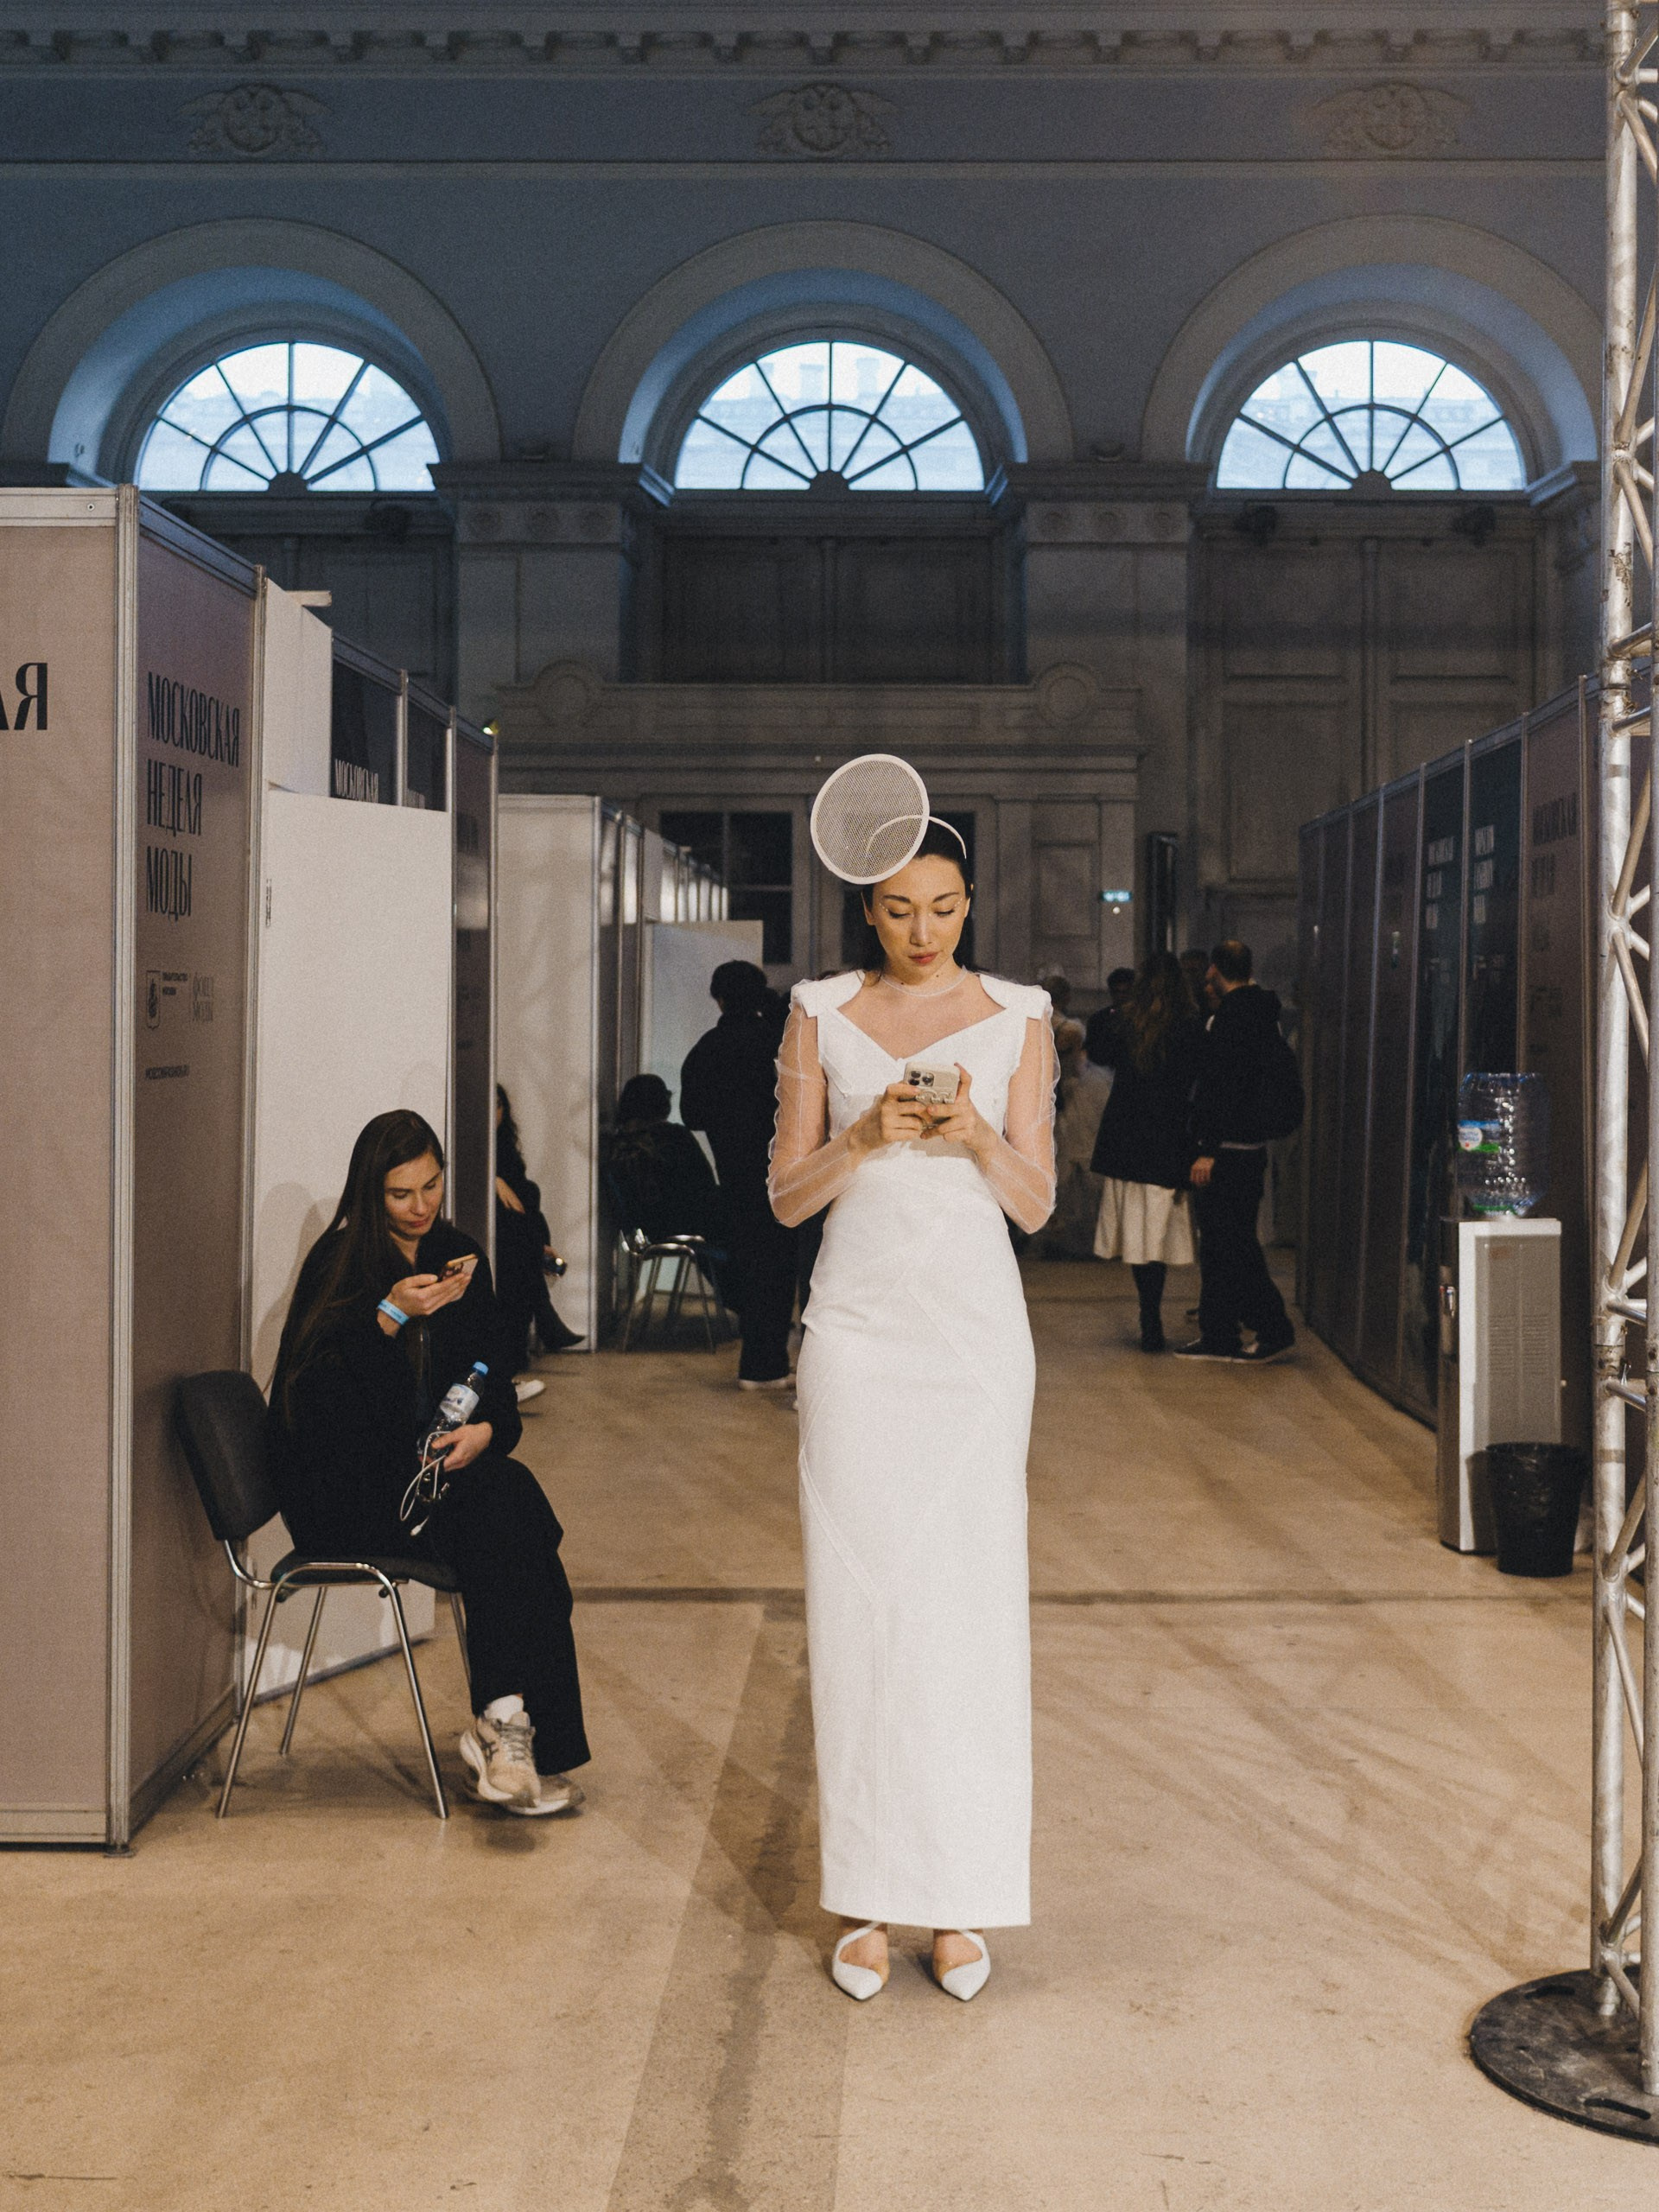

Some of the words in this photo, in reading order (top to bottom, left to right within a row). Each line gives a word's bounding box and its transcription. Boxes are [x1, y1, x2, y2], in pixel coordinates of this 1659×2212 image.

[148, 671, 239, 767] МОСКОВСКАЯ
[147, 759, 202, 837] НЕДЕЛЯ
[146, 846, 192, 923] МОДЫ
